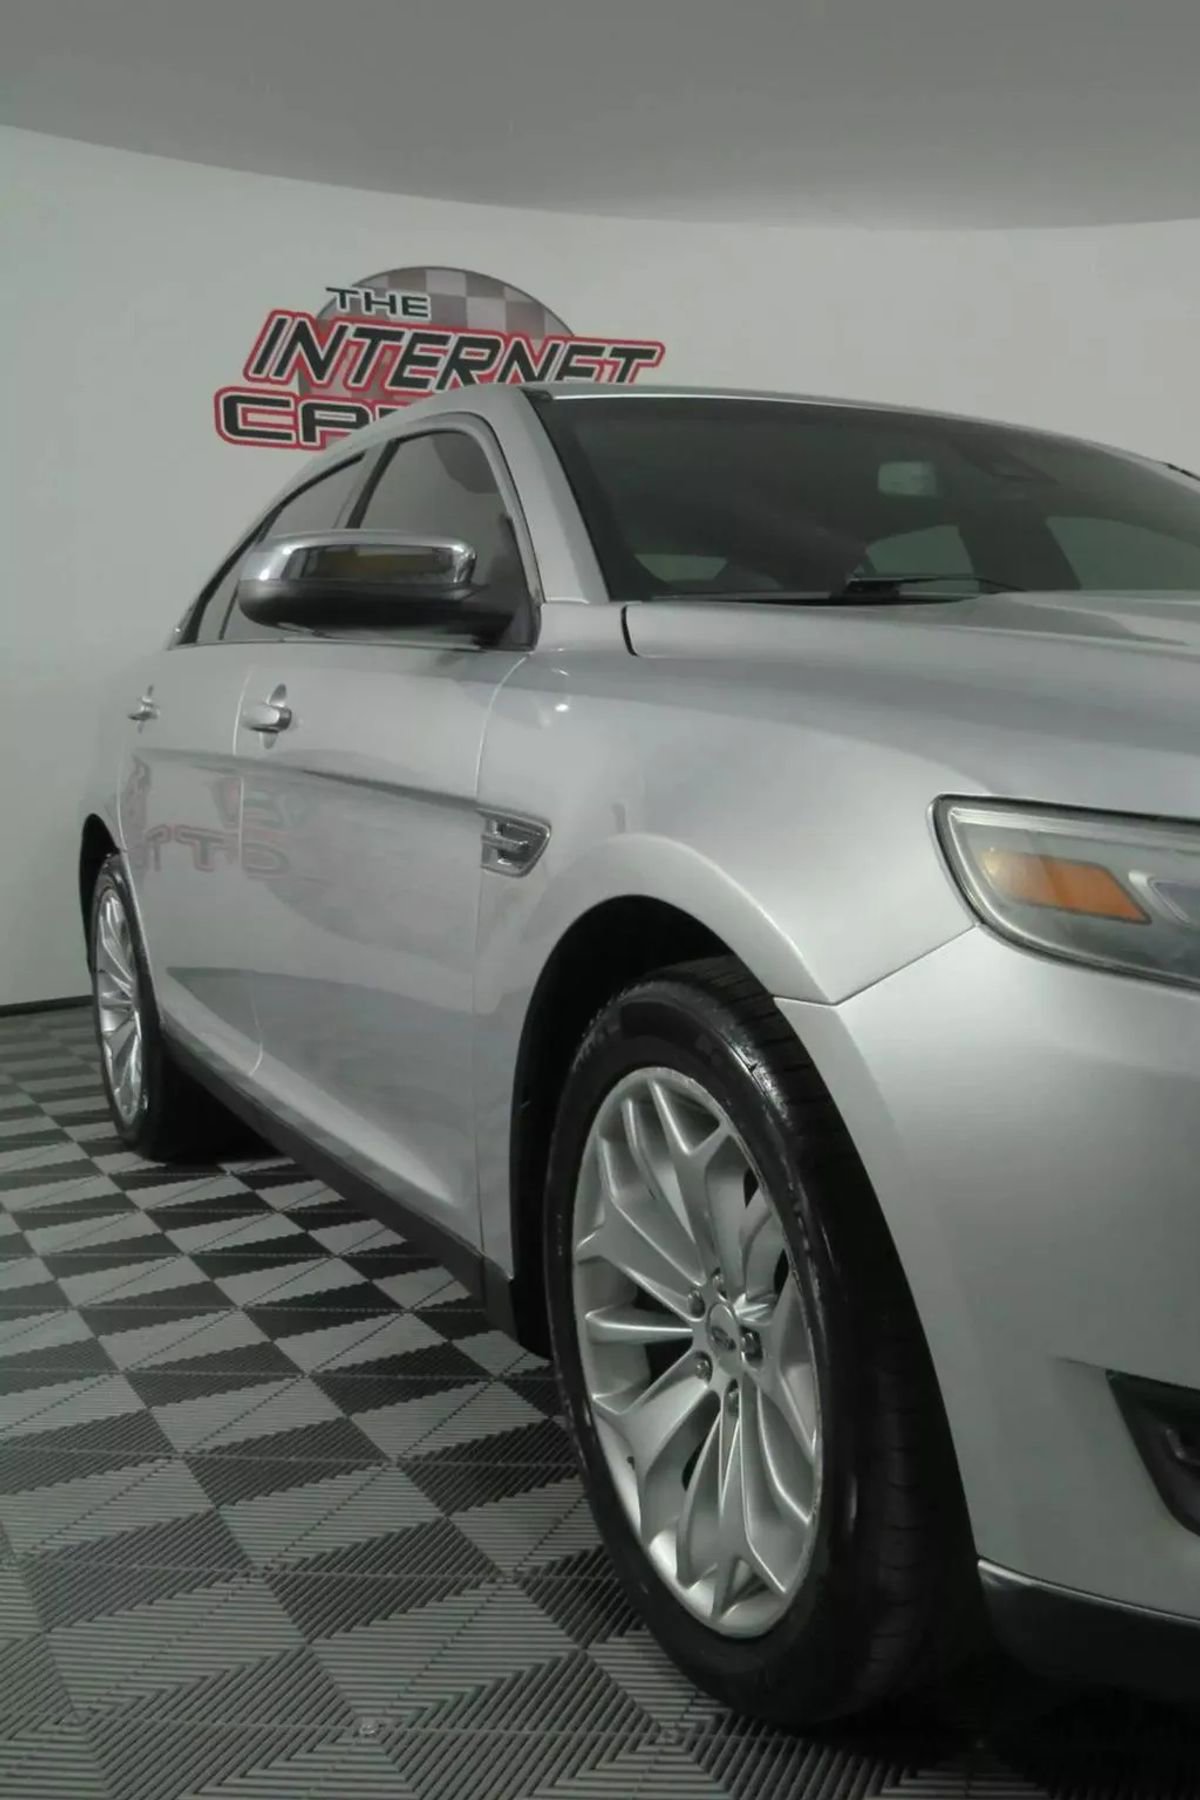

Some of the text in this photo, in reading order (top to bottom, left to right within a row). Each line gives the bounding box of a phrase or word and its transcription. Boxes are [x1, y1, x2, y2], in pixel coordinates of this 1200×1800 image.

[325, 284, 430, 319] THE
[250, 314, 661, 392] INTERNET
[218, 392, 400, 446] CA
